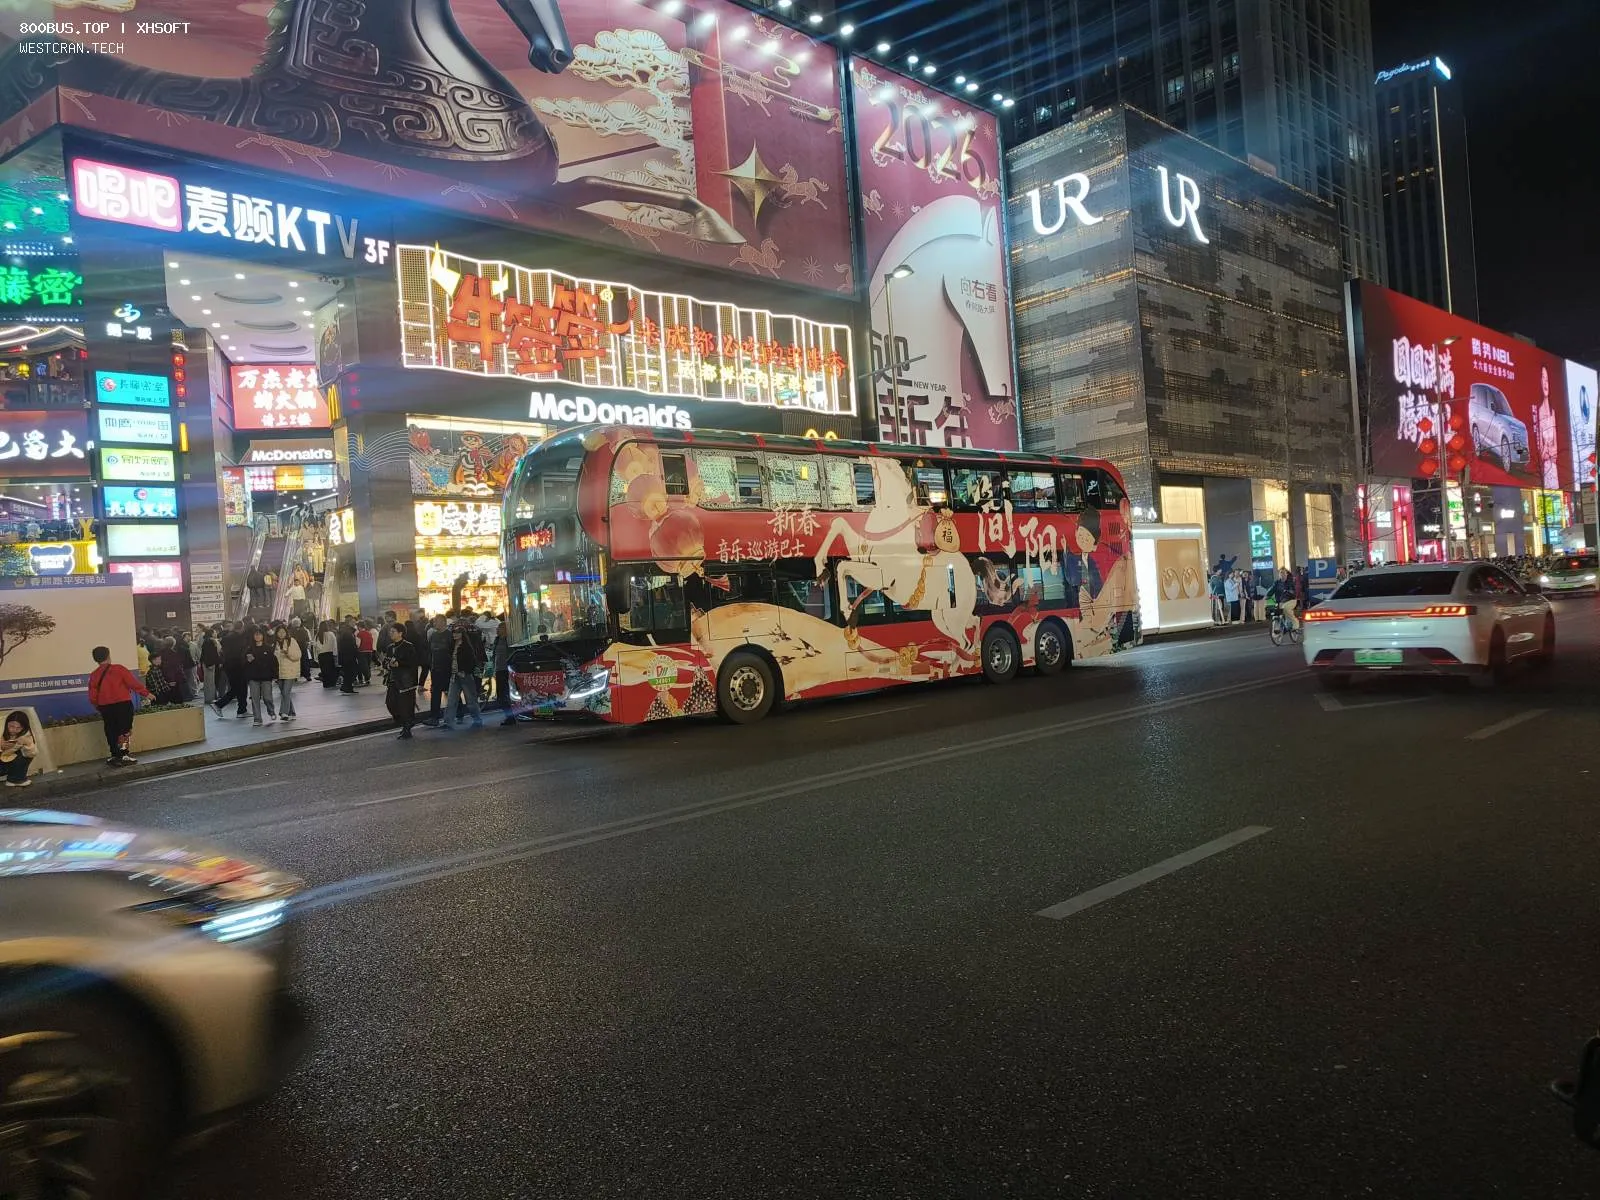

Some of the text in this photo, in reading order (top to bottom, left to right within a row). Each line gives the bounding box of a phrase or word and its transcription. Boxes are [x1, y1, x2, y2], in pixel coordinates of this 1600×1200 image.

[869, 100, 986, 189] 2026
[77, 166, 178, 228] 唱吧
[363, 237, 390, 265] 3F
[1026, 172, 1103, 235] UR
[1157, 165, 1210, 244] UR
[960, 276, 997, 302] 向右看
[913, 380, 947, 393] NEW YEAR
[528, 391, 692, 430] McDonald's
[251, 448, 333, 462] McDonald's
[766, 502, 822, 540] 新春
[942, 527, 953, 543] 福
[1251, 525, 1263, 541] P
[715, 538, 806, 566] 音乐巡游巴士
[1315, 560, 1328, 578] P
